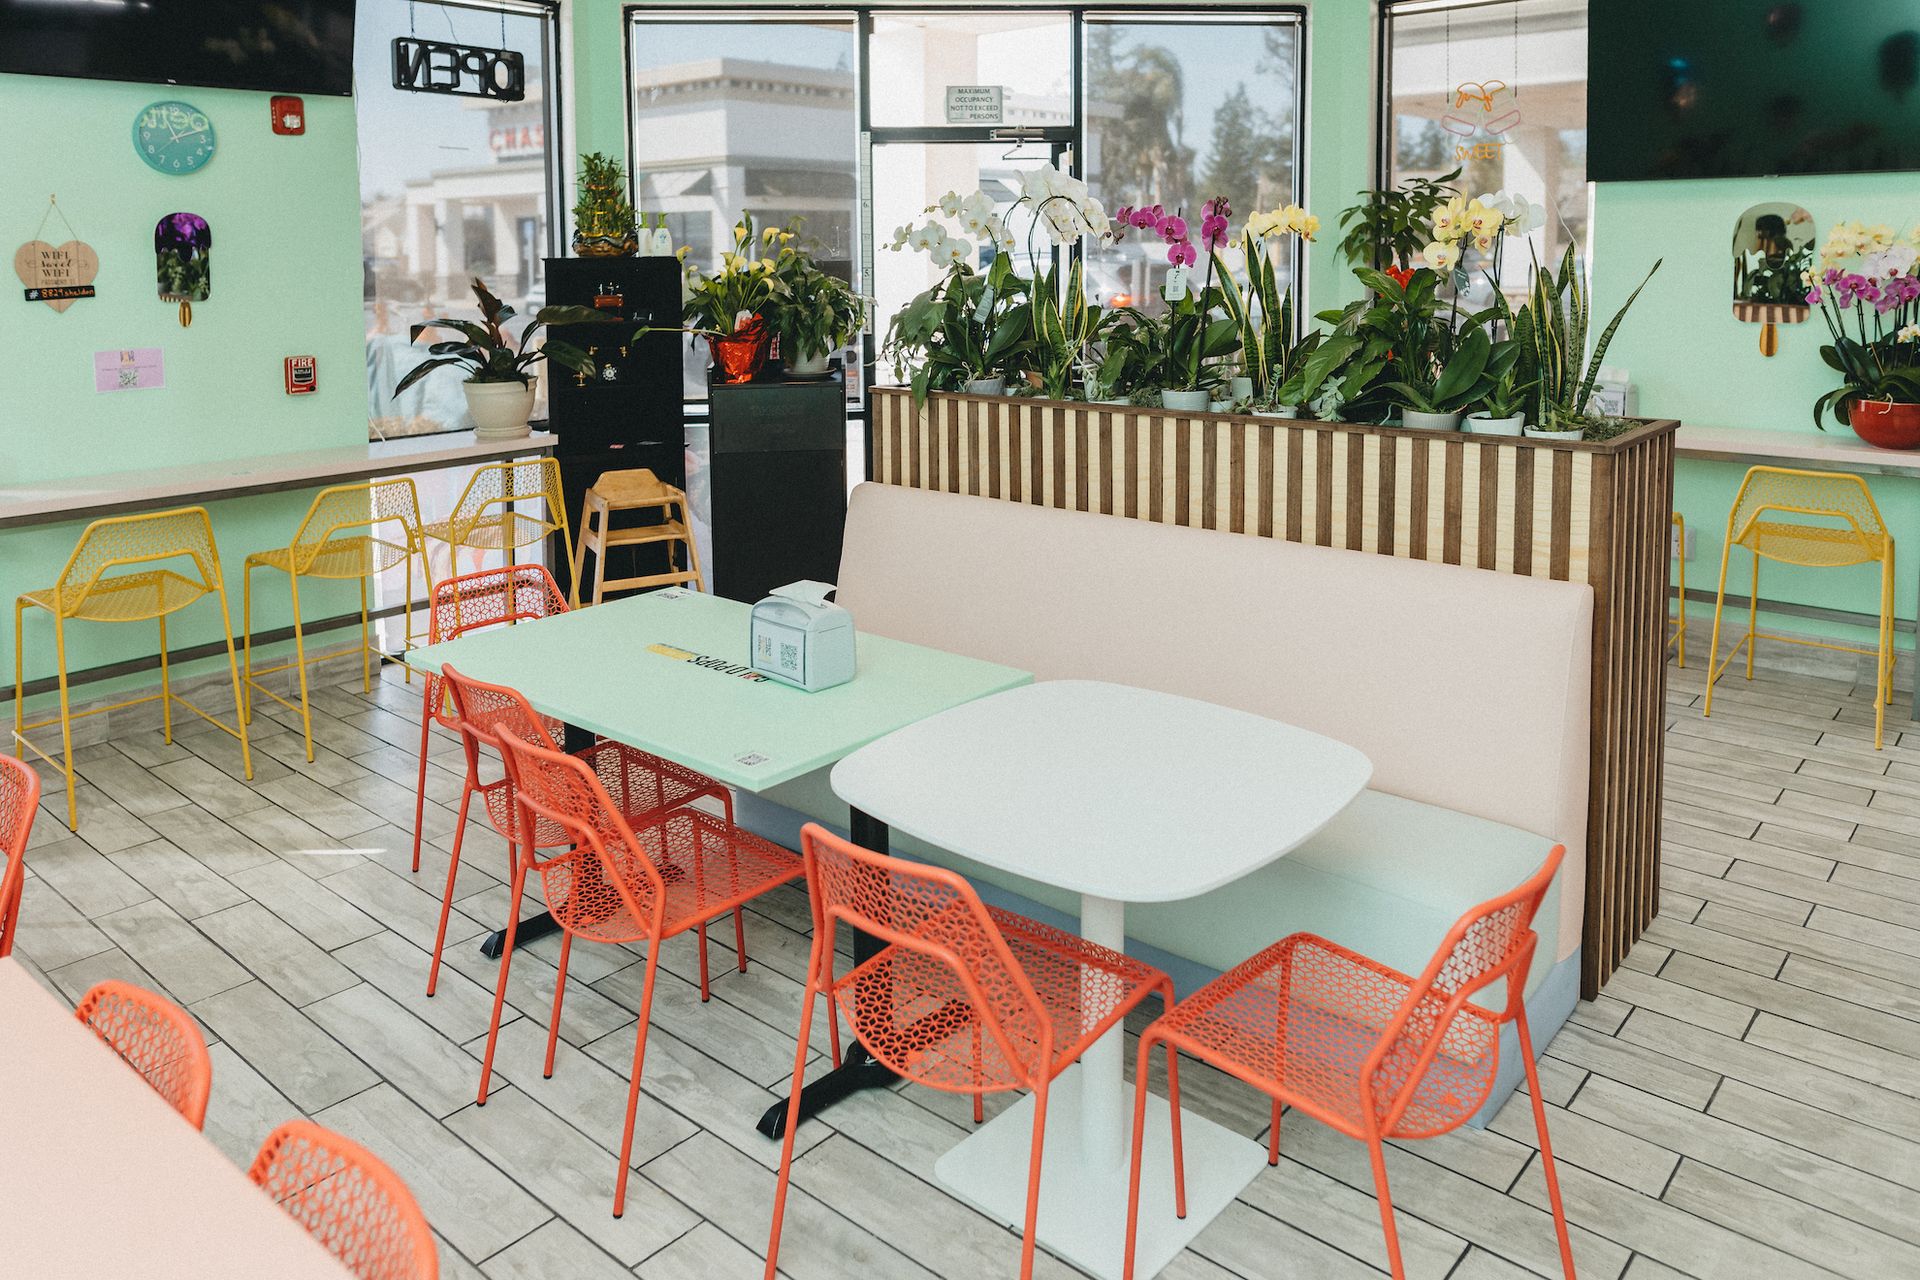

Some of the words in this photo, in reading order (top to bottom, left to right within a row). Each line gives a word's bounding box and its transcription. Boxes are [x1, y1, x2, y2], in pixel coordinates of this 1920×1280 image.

[143, 131, 150, 140] 9
[200, 135, 206, 144] 3
[148, 144, 155, 154] 8
[196, 148, 203, 156] 4
[160, 155, 165, 164] 7
[173, 159, 180, 168] 6
[187, 156, 193, 165] 5
[41, 251, 70, 260] WIFI
[42, 269, 70, 277] WIFI
[292, 358, 313, 367] FIRE
